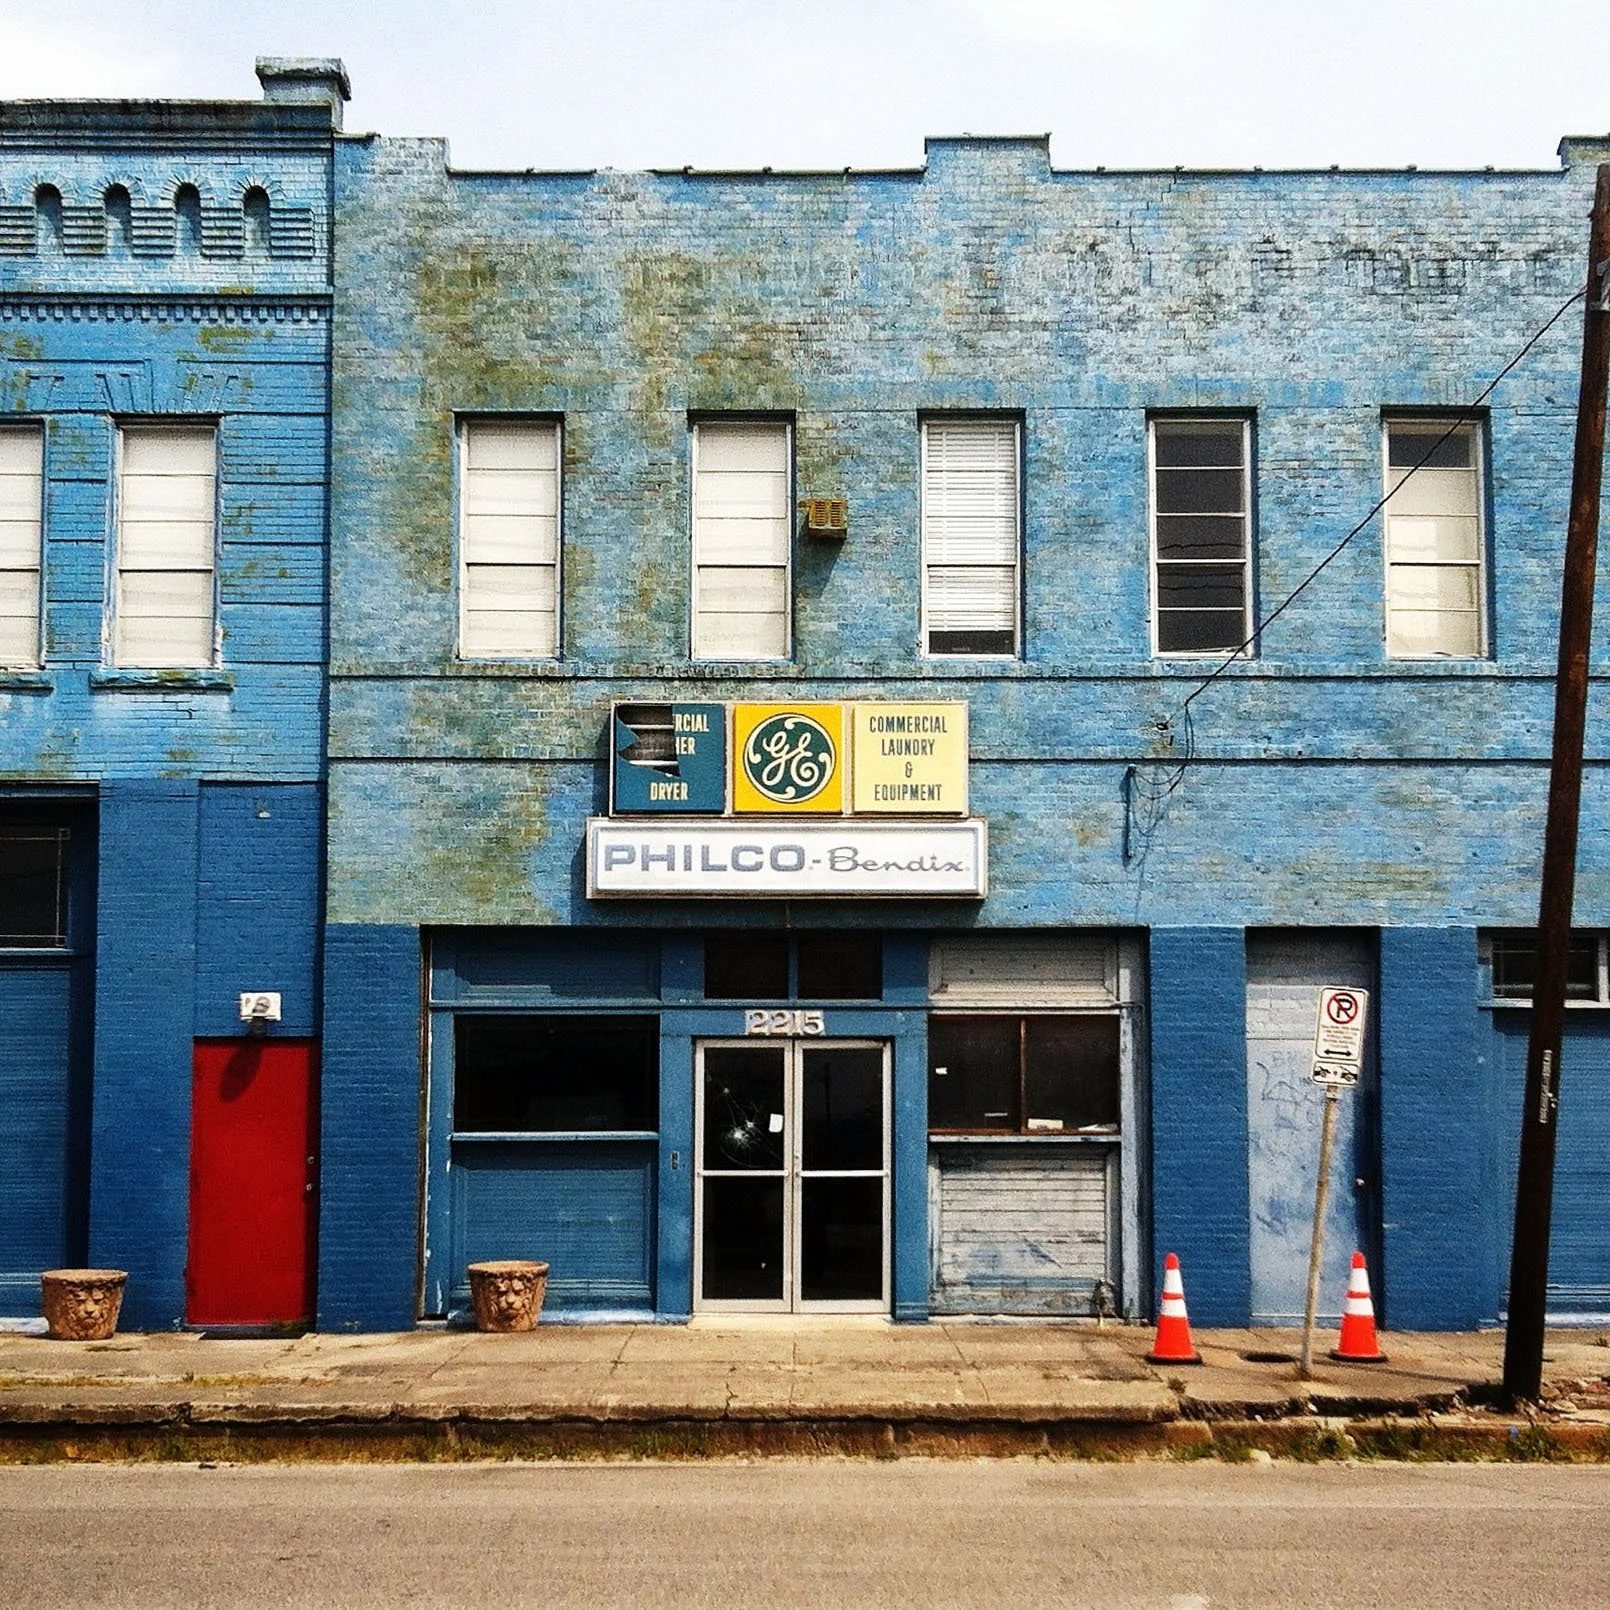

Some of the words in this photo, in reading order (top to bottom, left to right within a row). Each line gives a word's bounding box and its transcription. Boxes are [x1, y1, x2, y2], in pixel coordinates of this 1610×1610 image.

[869, 716, 948, 733] COMMERCIAL
[881, 738, 936, 756] LAUNDRY
[904, 761, 913, 778] &
[649, 782, 689, 801] DRYER
[874, 784, 943, 801] EQUIPMENT
[746, 1010, 825, 1034] 2215
